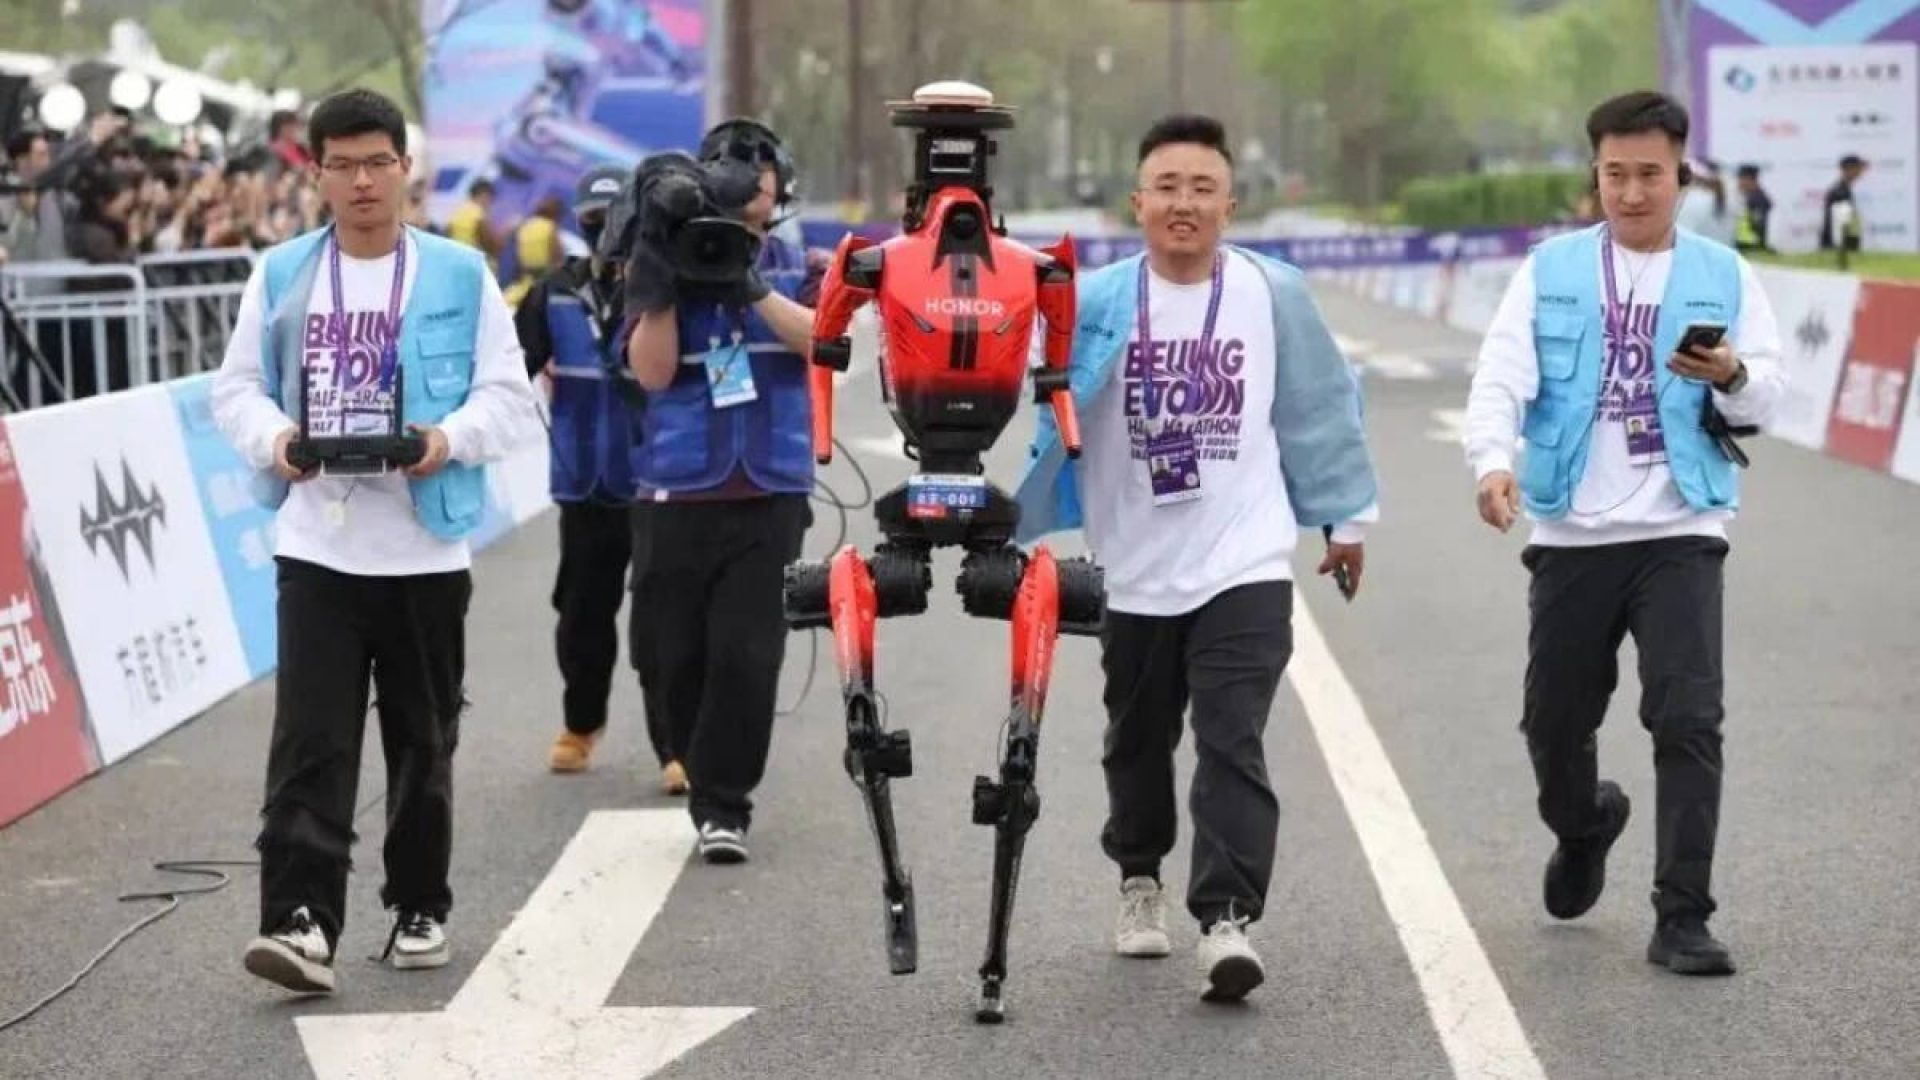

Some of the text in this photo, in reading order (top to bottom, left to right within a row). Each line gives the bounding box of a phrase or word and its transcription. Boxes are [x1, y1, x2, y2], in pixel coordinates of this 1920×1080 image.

[925, 299, 1004, 316] HONOR
[306, 312, 402, 347] BEIJIN
[306, 351, 384, 388] E-TO
[1125, 339, 1245, 377] BEIJING
[1125, 379, 1245, 416] ETOWN
